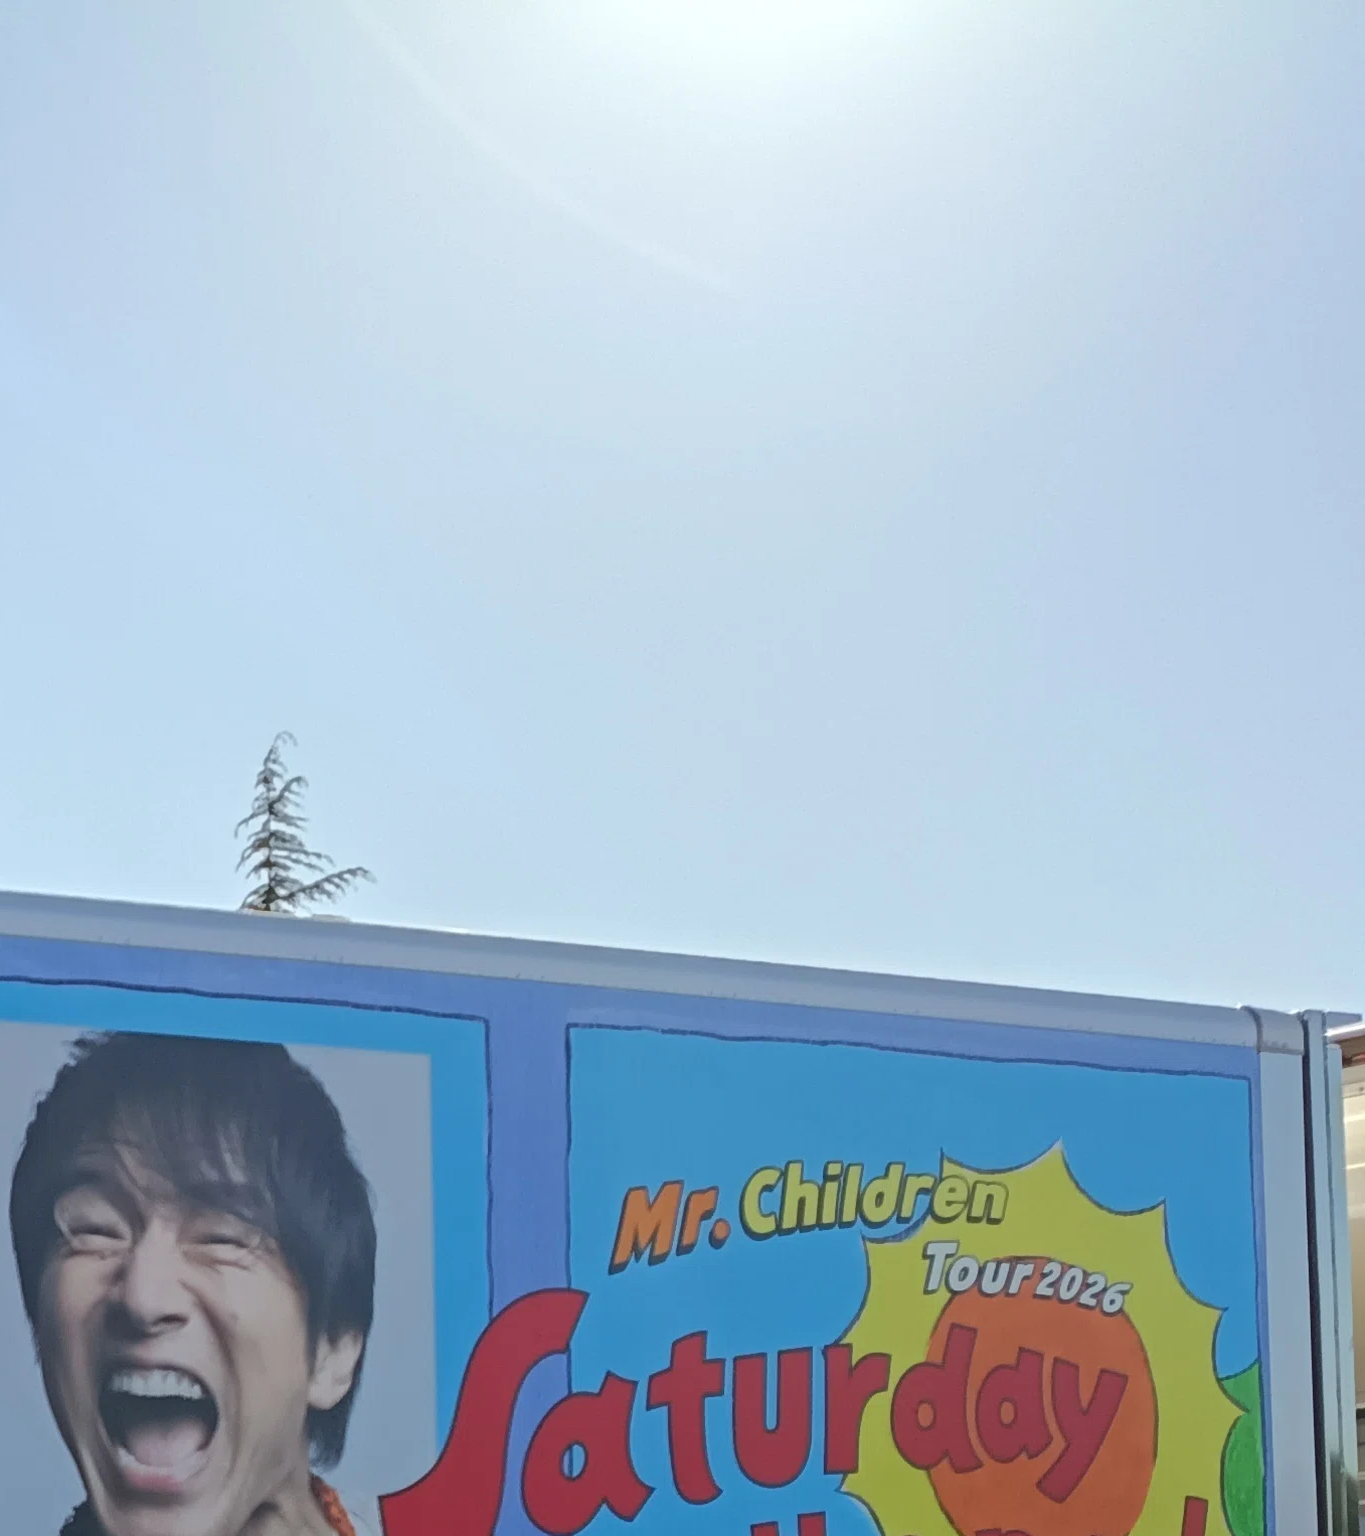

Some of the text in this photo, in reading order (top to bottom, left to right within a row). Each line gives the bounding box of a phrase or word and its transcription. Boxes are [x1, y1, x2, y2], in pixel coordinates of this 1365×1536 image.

[608, 1160, 1009, 1275] Mr. Children
[922, 1240, 1132, 1315] Tour 2026
